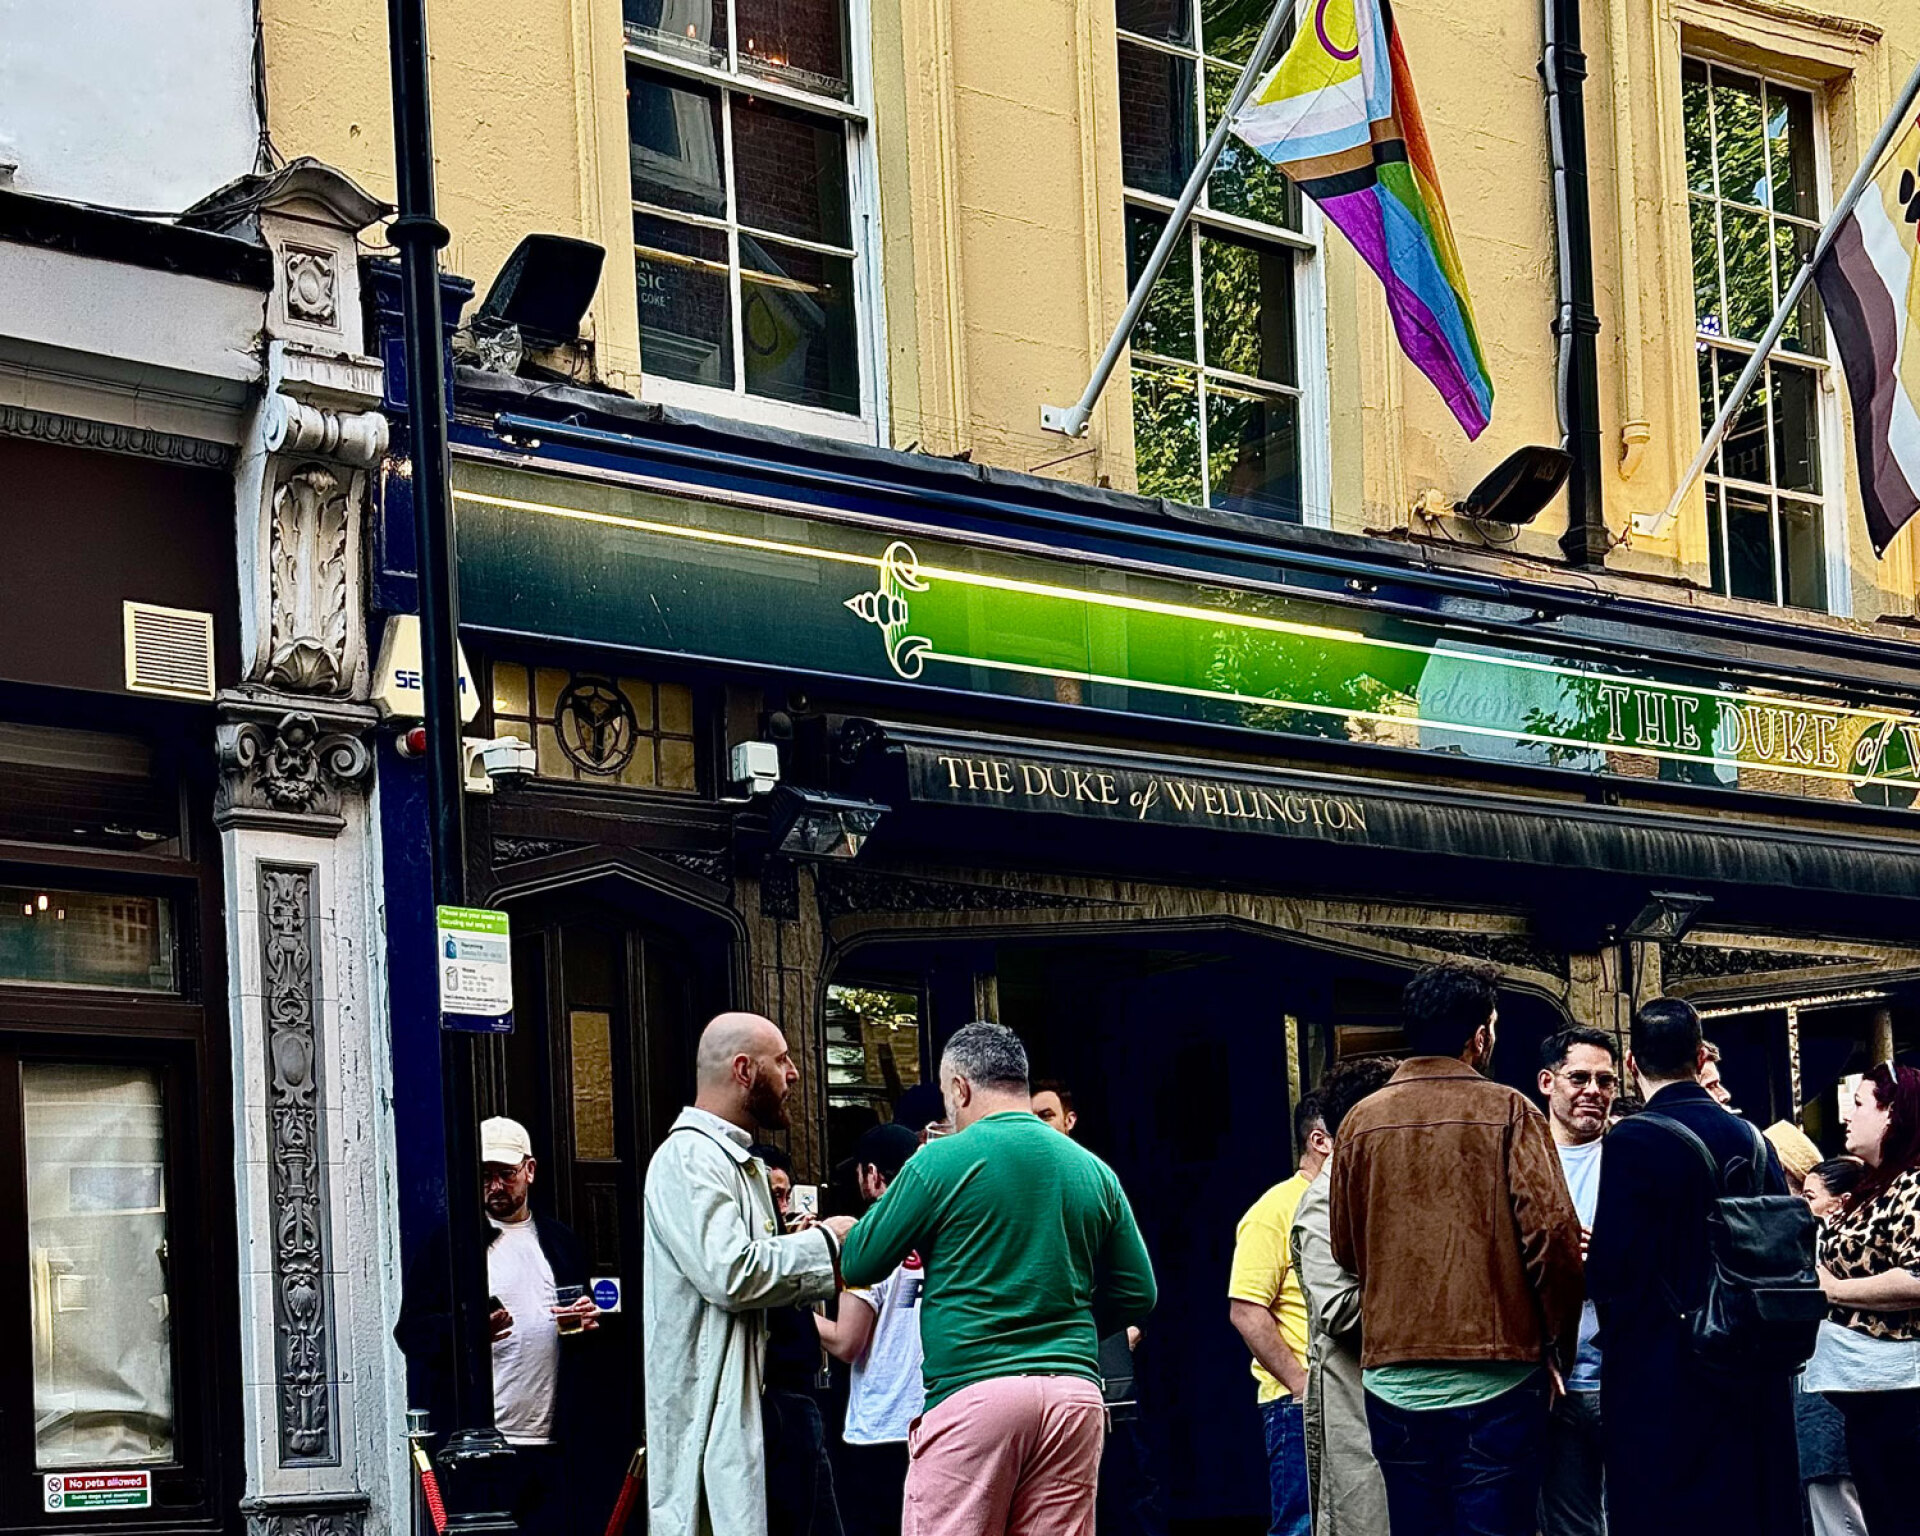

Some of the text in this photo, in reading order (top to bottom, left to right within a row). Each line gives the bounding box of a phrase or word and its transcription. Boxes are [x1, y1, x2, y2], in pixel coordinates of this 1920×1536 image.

[1598, 683, 1701, 750] THE
[1716, 700, 1839, 767] DUKE
[1855, 718, 1892, 787] of
[938, 756, 1367, 831] THE DUKE of WELLINGTON
[69, 1477, 142, 1489] No pets allowed
